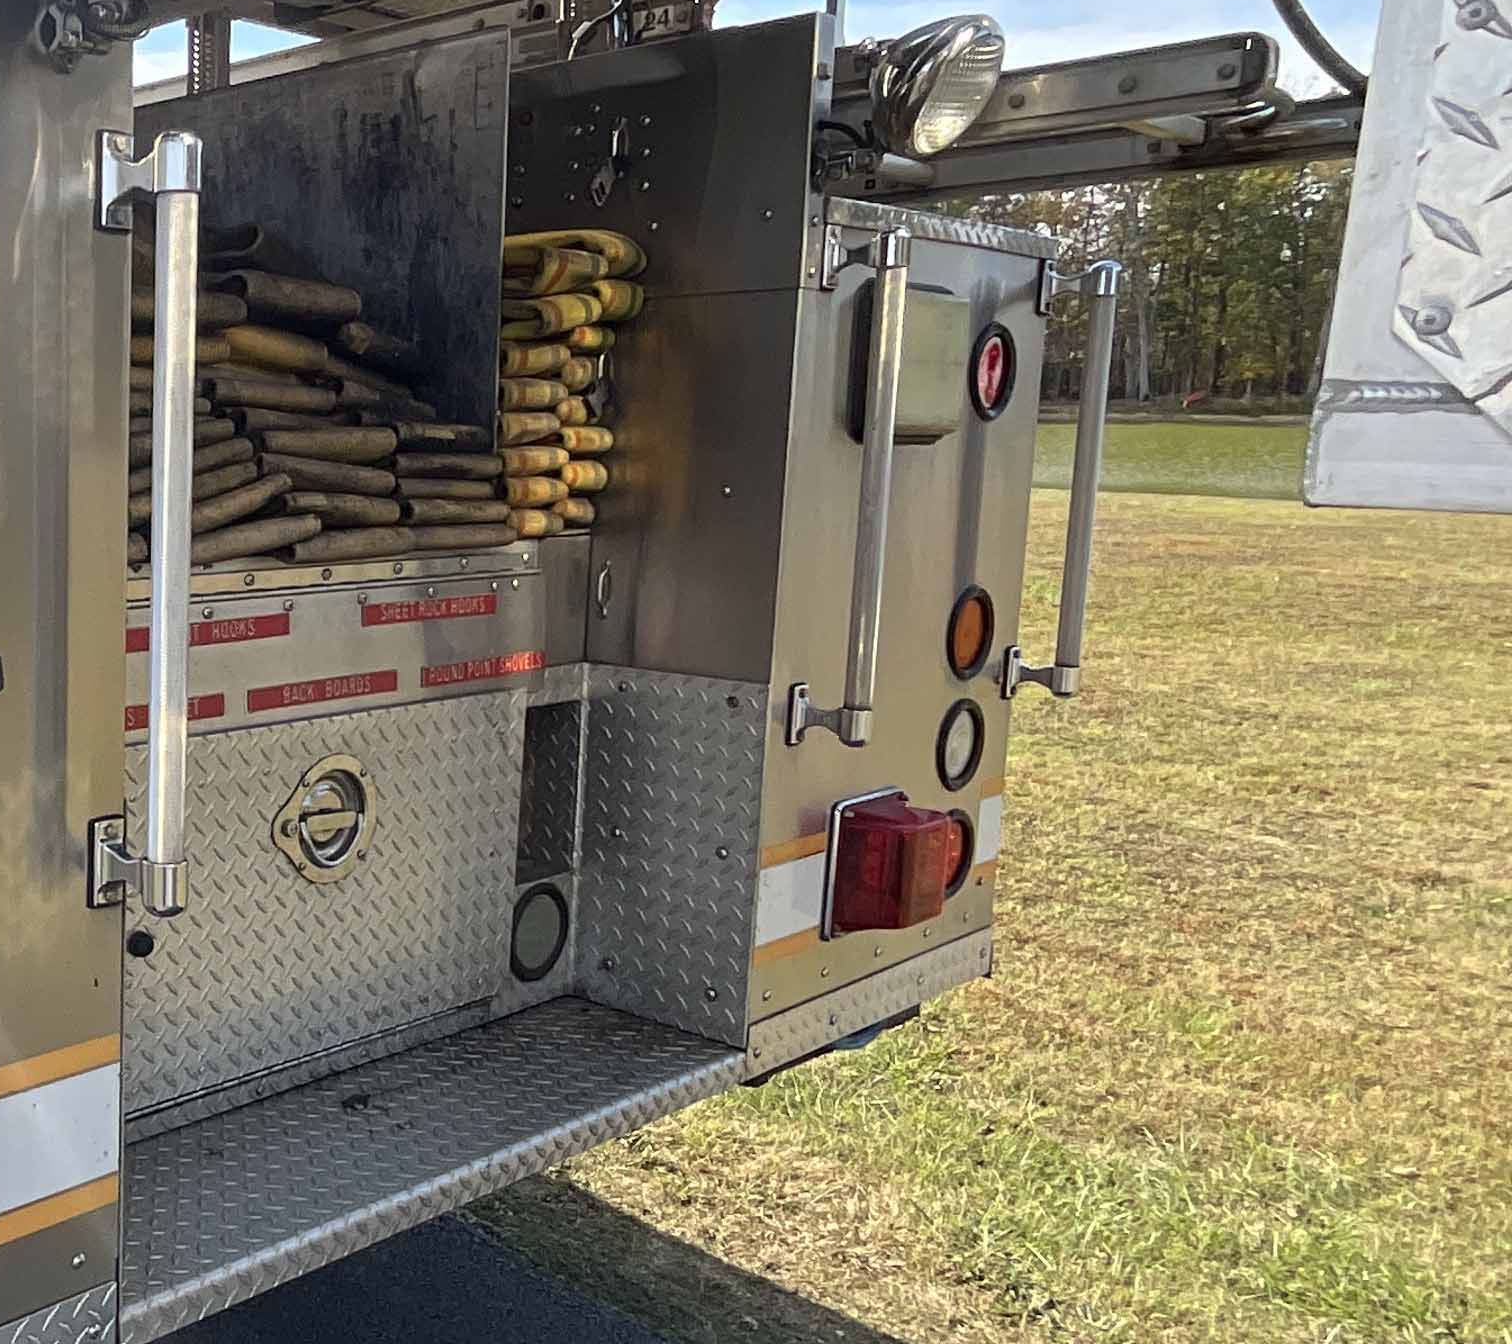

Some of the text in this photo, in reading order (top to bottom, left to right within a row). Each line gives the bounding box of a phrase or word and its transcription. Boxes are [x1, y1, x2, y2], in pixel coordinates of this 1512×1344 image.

[381, 596, 485, 621] SHEET ROCK HOOKS
[211, 618, 256, 640] HOOKS
[428, 651, 544, 683] ROUND POINT SHOVELS
[282, 675, 373, 704] BACK BOARDS
